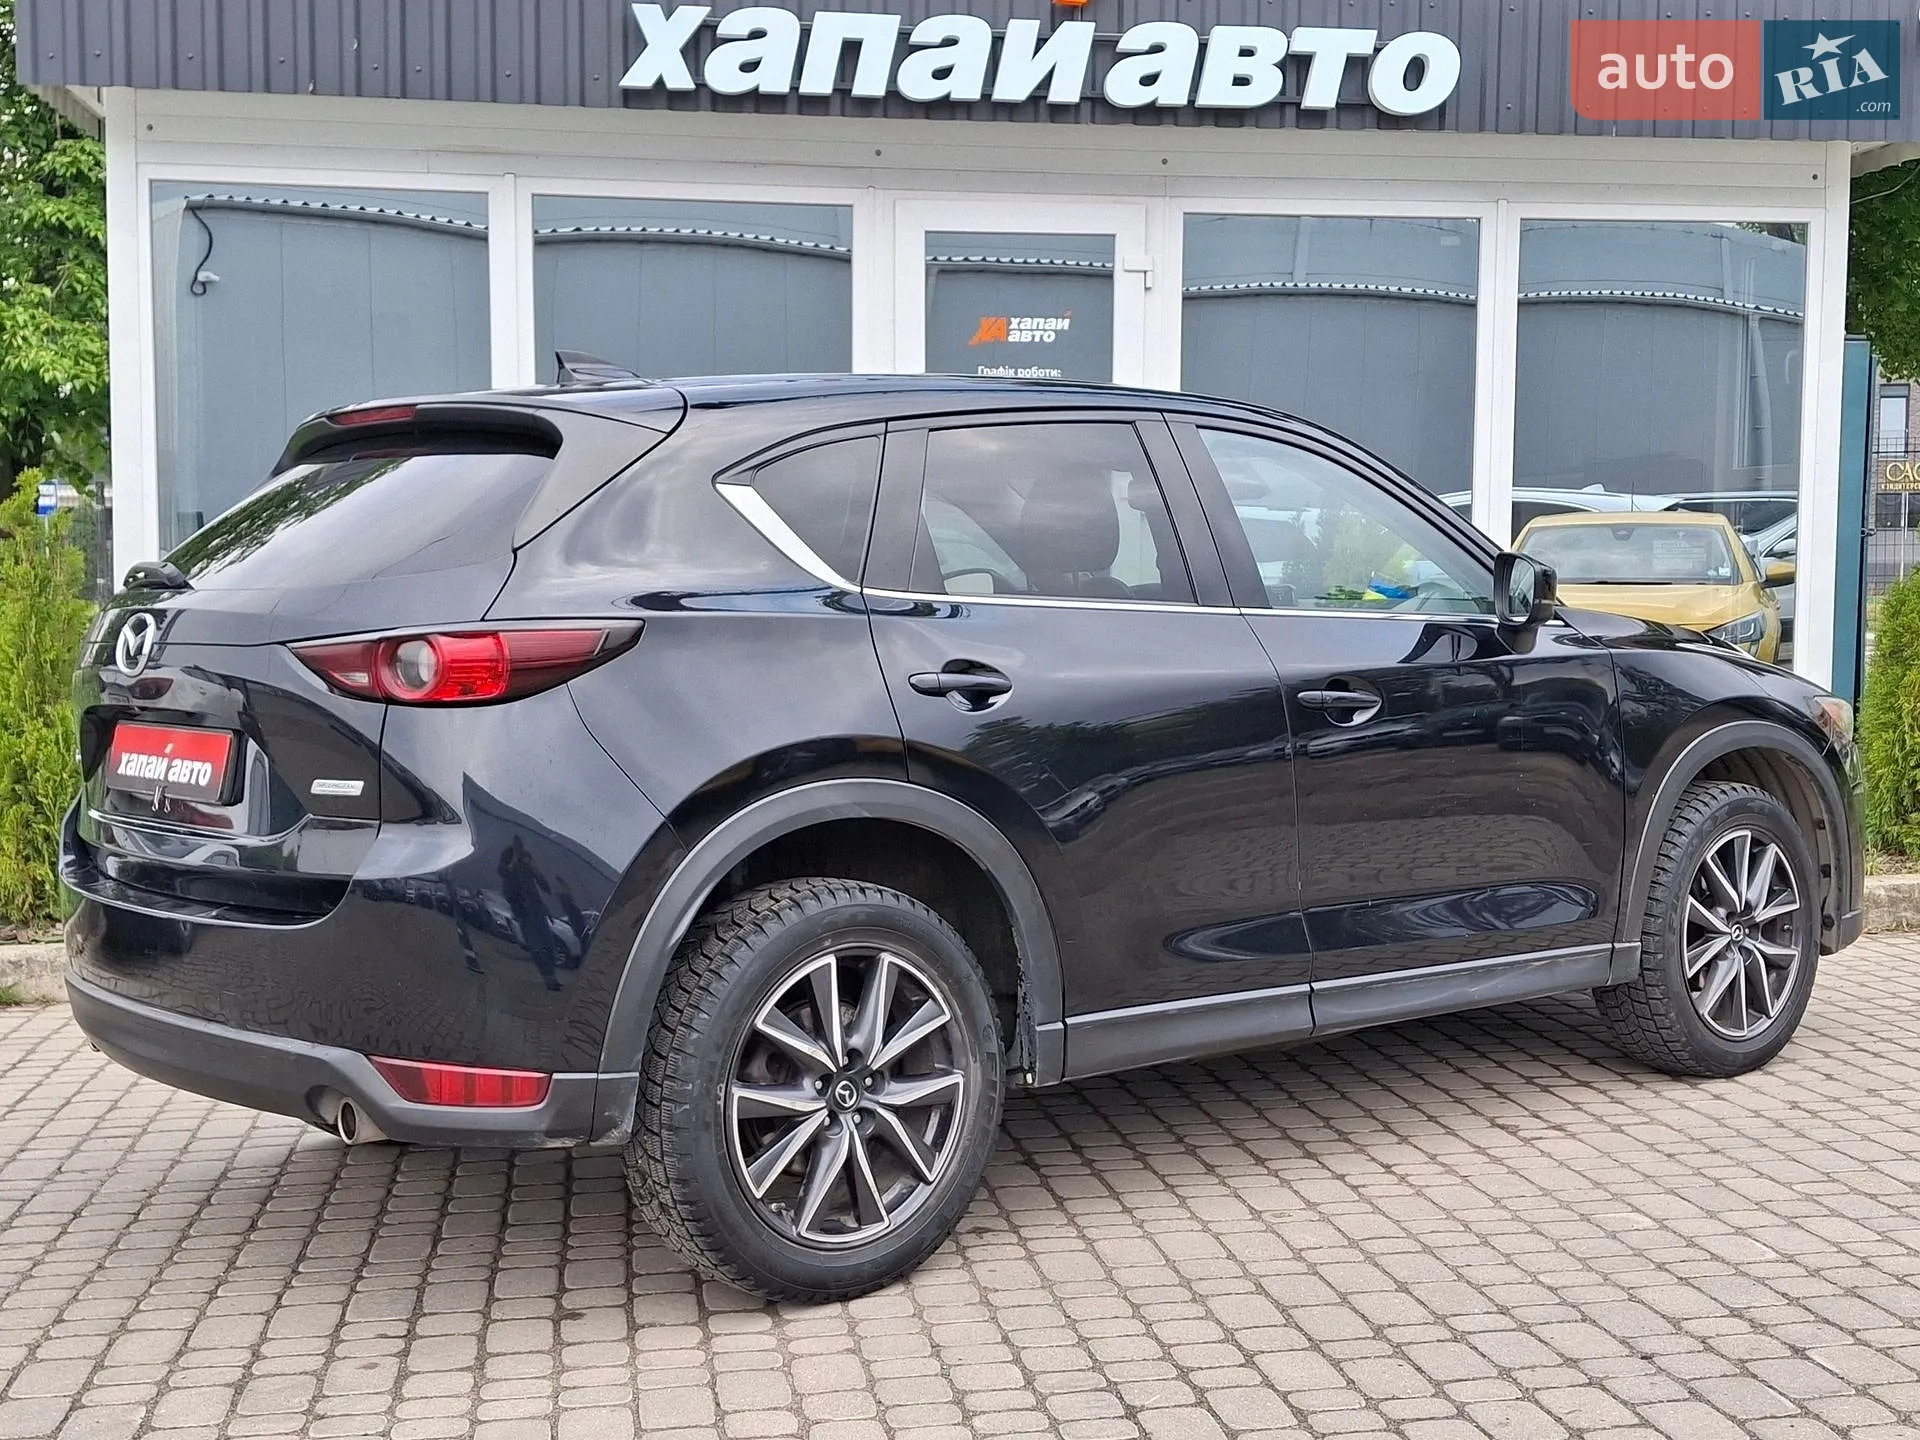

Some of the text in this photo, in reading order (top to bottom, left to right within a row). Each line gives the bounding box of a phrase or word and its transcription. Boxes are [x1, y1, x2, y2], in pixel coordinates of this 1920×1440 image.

[1104, 20, 1462, 115] авто
[1008, 310, 1073, 331] хапай
[1008, 330, 1056, 343] авто
[977, 365, 1016, 377] Графік
[117, 742, 213, 787] хапай авто
